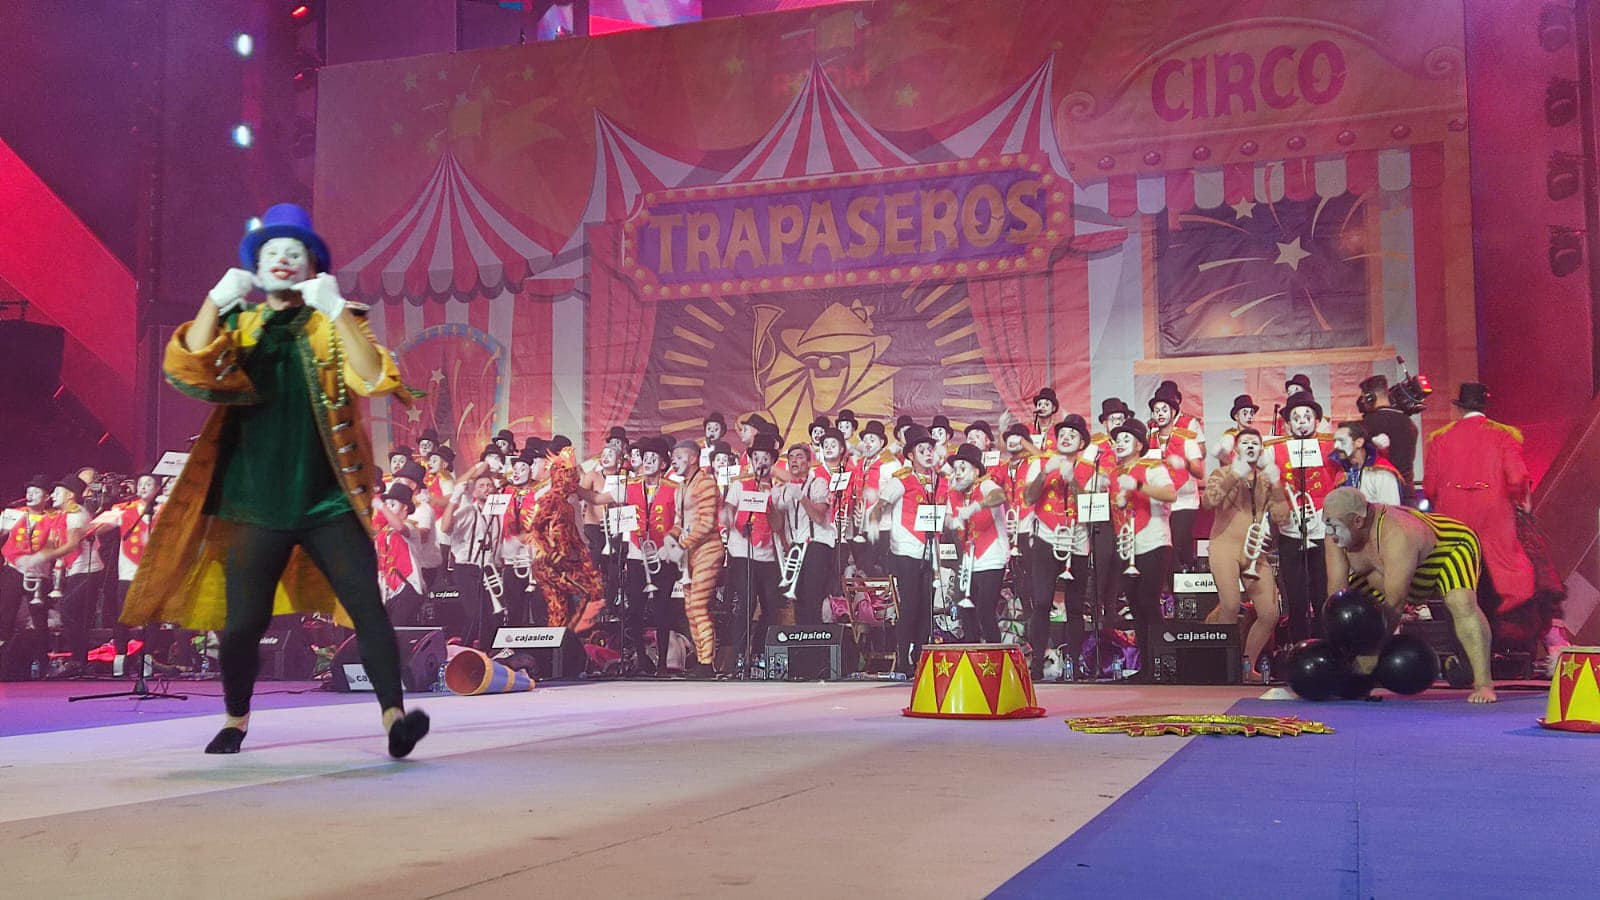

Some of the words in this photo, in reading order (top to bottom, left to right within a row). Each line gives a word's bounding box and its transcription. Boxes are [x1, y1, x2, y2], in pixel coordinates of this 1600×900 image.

[1151, 40, 1347, 122] CIRCO
[649, 179, 1044, 276] TRAPASEROS
[515, 634, 554, 642] cajasiete
[790, 632, 831, 641] cajasiete
[1177, 632, 1227, 641] cajasiete
